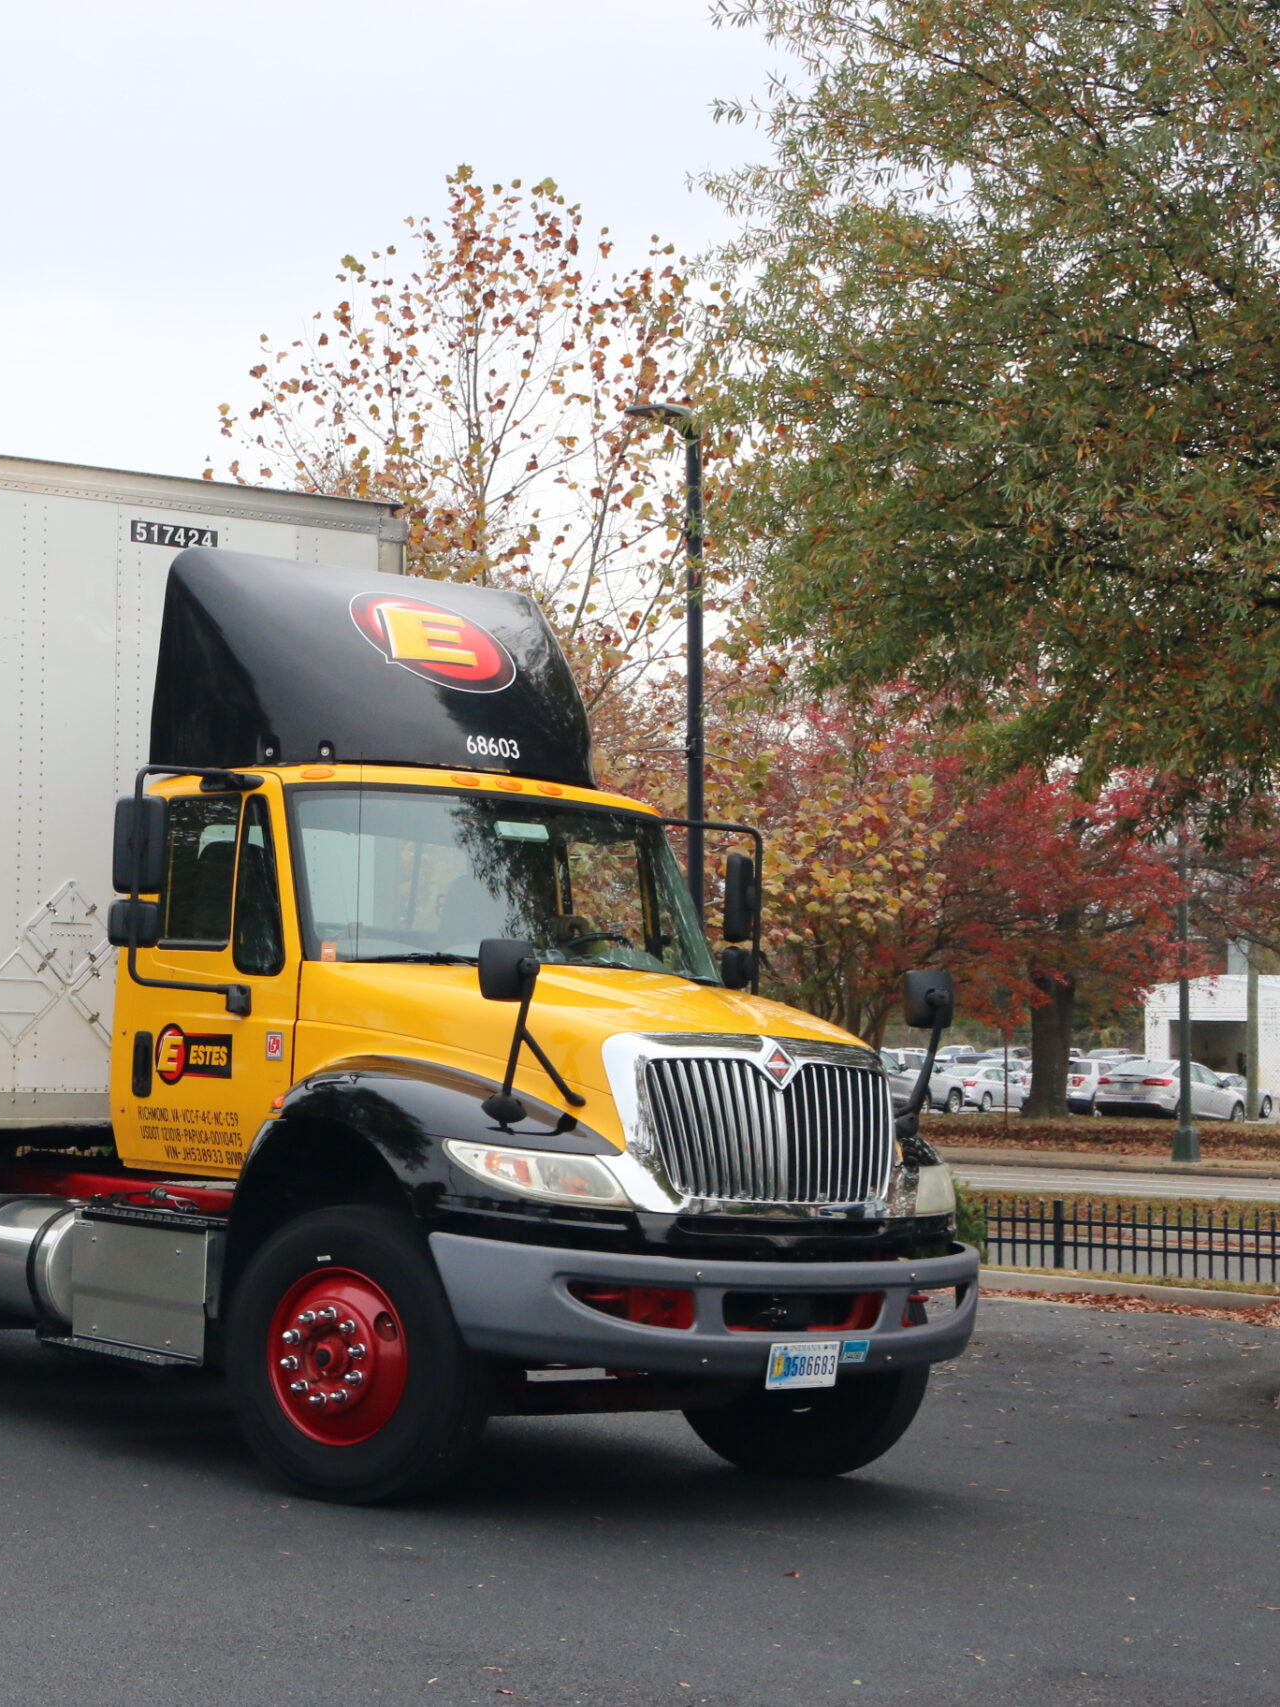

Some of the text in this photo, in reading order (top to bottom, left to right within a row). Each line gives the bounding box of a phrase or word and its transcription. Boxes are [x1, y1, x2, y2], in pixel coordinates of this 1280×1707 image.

[135, 522, 213, 547] 517424
[376, 606, 479, 667] E
[466, 735, 520, 759] 68603
[156, 1035, 228, 1072] E ESTES
[140, 1125, 160, 1140] USDOT
[182, 1147, 224, 1164] JH538933
